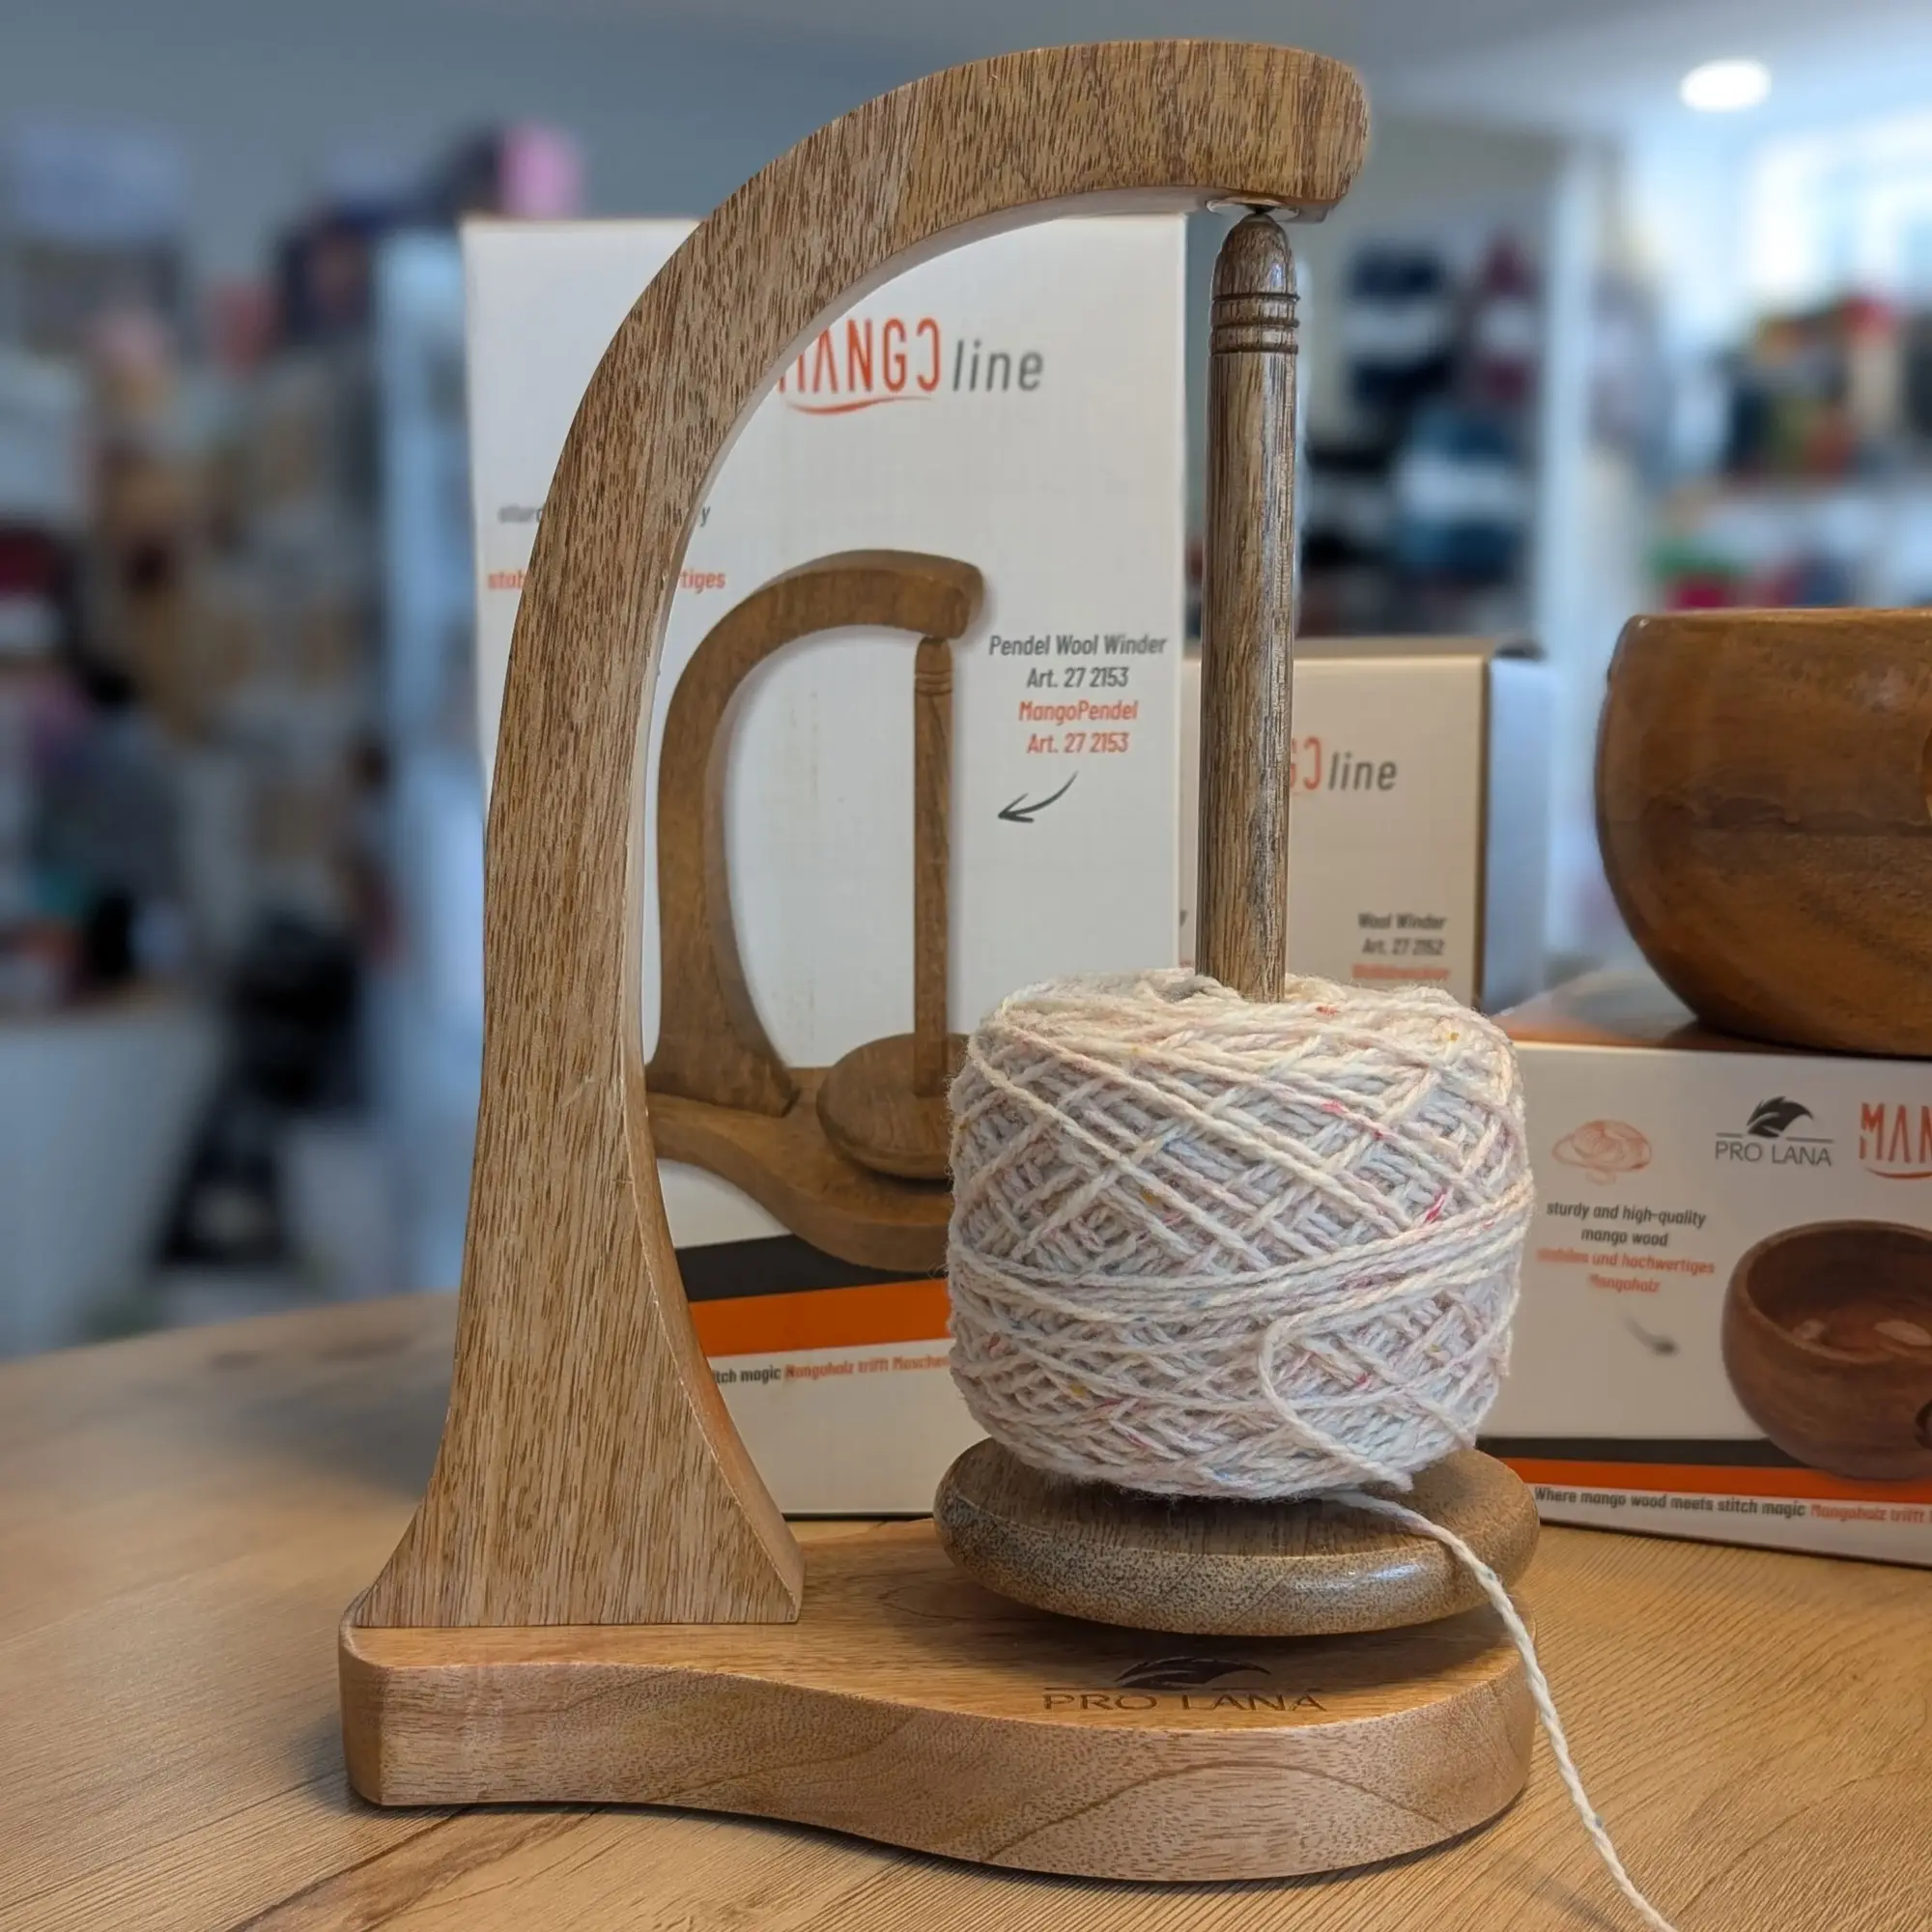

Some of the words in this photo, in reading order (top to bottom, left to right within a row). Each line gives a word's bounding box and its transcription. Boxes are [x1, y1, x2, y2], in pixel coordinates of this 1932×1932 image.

[952, 338, 1044, 393] line
[988, 635, 1051, 656] Pendel
[1056, 634, 1099, 656] Wool
[1104, 634, 1168, 655] Winder
[1026, 668, 1059, 688] Art.
[1064, 667, 1087, 688] 27
[1090, 667, 1129, 688] 2153
[1018, 699, 1140, 726] MangoPendel
[1026, 733, 1059, 753] Art.
[1065, 732, 1087, 753] 27
[1090, 731, 1130, 753] 2153
[1327, 751, 1399, 792] line
[1716, 1141, 1763, 1163] PRO
[1772, 1144, 1833, 1168] LANA
[1547, 1202, 1590, 1220] sturdy
[1594, 1206, 1619, 1220] and
[1622, 1206, 1707, 1229] high-quality
[1581, 1228, 1628, 1246] mango
[1632, 1233, 1669, 1247] wood
[1592, 1252, 1619, 1266] und
[1622, 1253, 1716, 1276] hochwertiges
[740, 1364, 782, 1385] magic
[1534, 1487, 1577, 1503] Where
[1579, 1491, 1627, 1509] mango
[1631, 1493, 1666, 1509] wood
[1671, 1496, 1714, 1512] meets
[1718, 1497, 1758, 1515] stitch
[1762, 1499, 1806, 1520] magic
[1042, 1692, 1158, 1711] PRO
[1180, 1690, 1328, 1713] LANA
